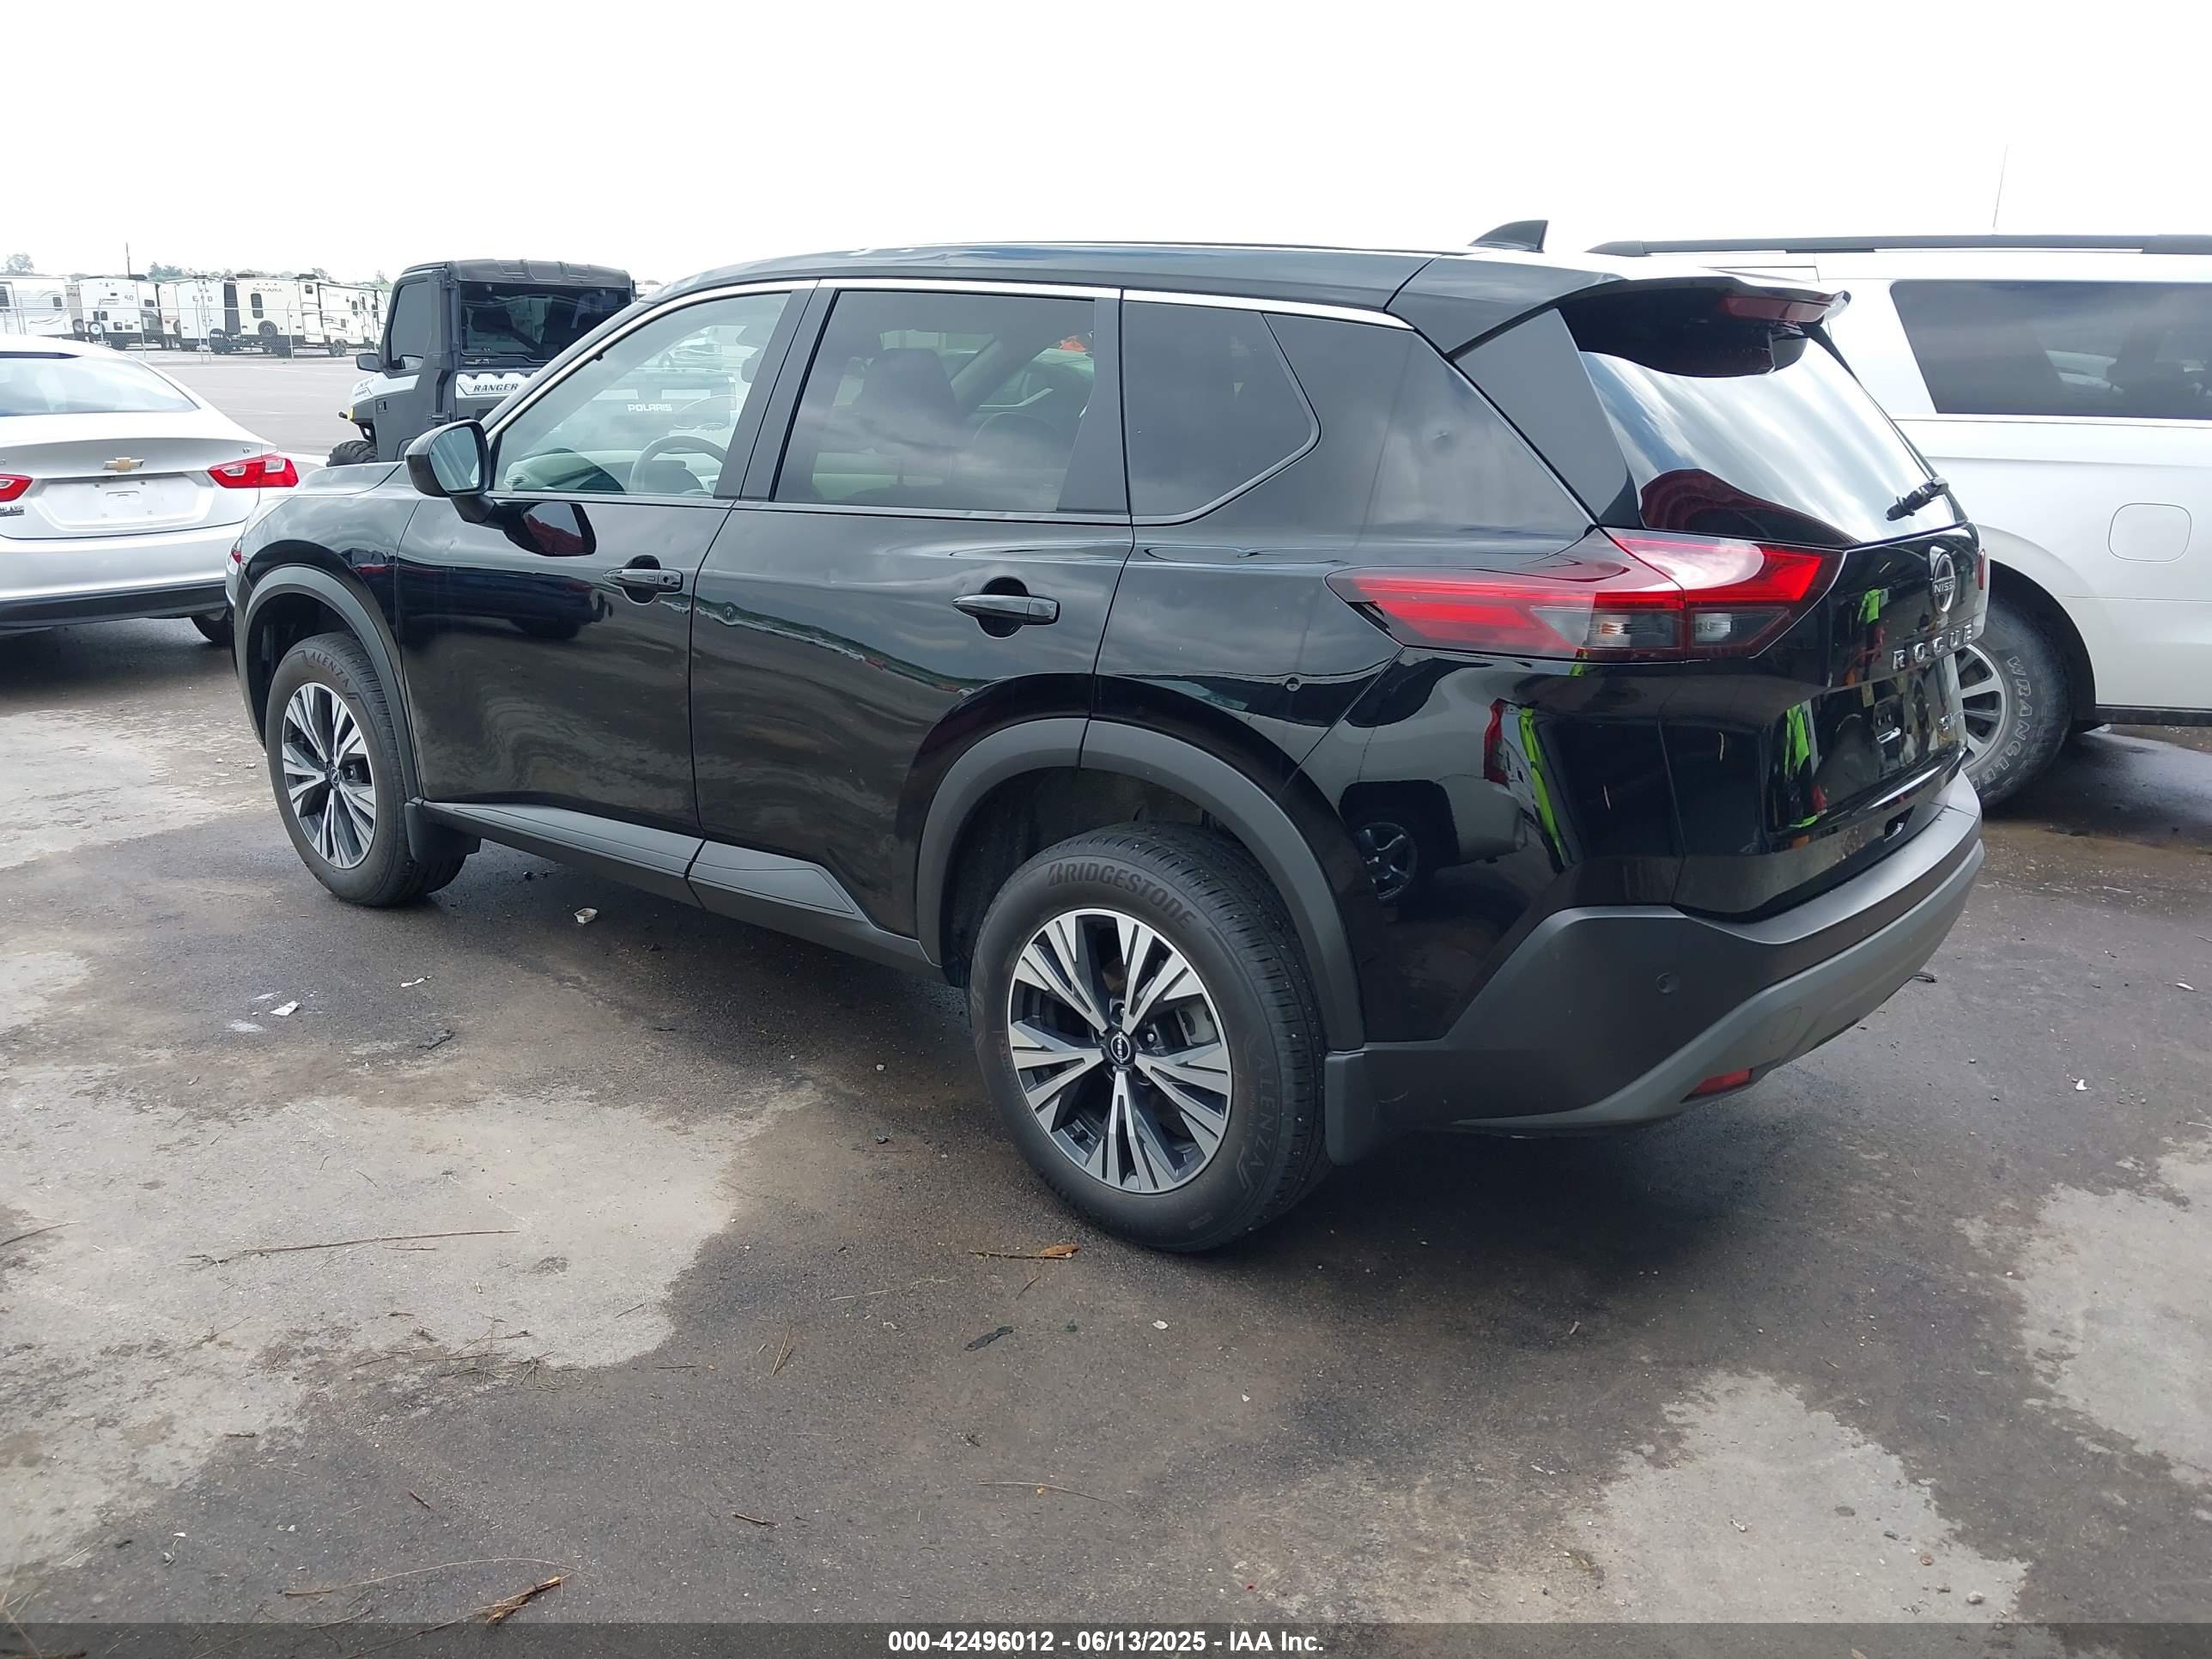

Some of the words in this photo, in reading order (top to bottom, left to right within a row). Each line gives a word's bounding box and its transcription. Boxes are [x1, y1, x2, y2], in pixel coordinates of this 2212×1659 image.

[473, 383, 519, 392] RANGER
[626, 403, 673, 413] POLARIS
[1892, 623, 1972, 670] ROGUE
[310, 649, 351, 689] ALENZA
[1048, 862, 1198, 929] BRIDGESTONE
[1249, 1053, 1276, 1168] ALENZA
